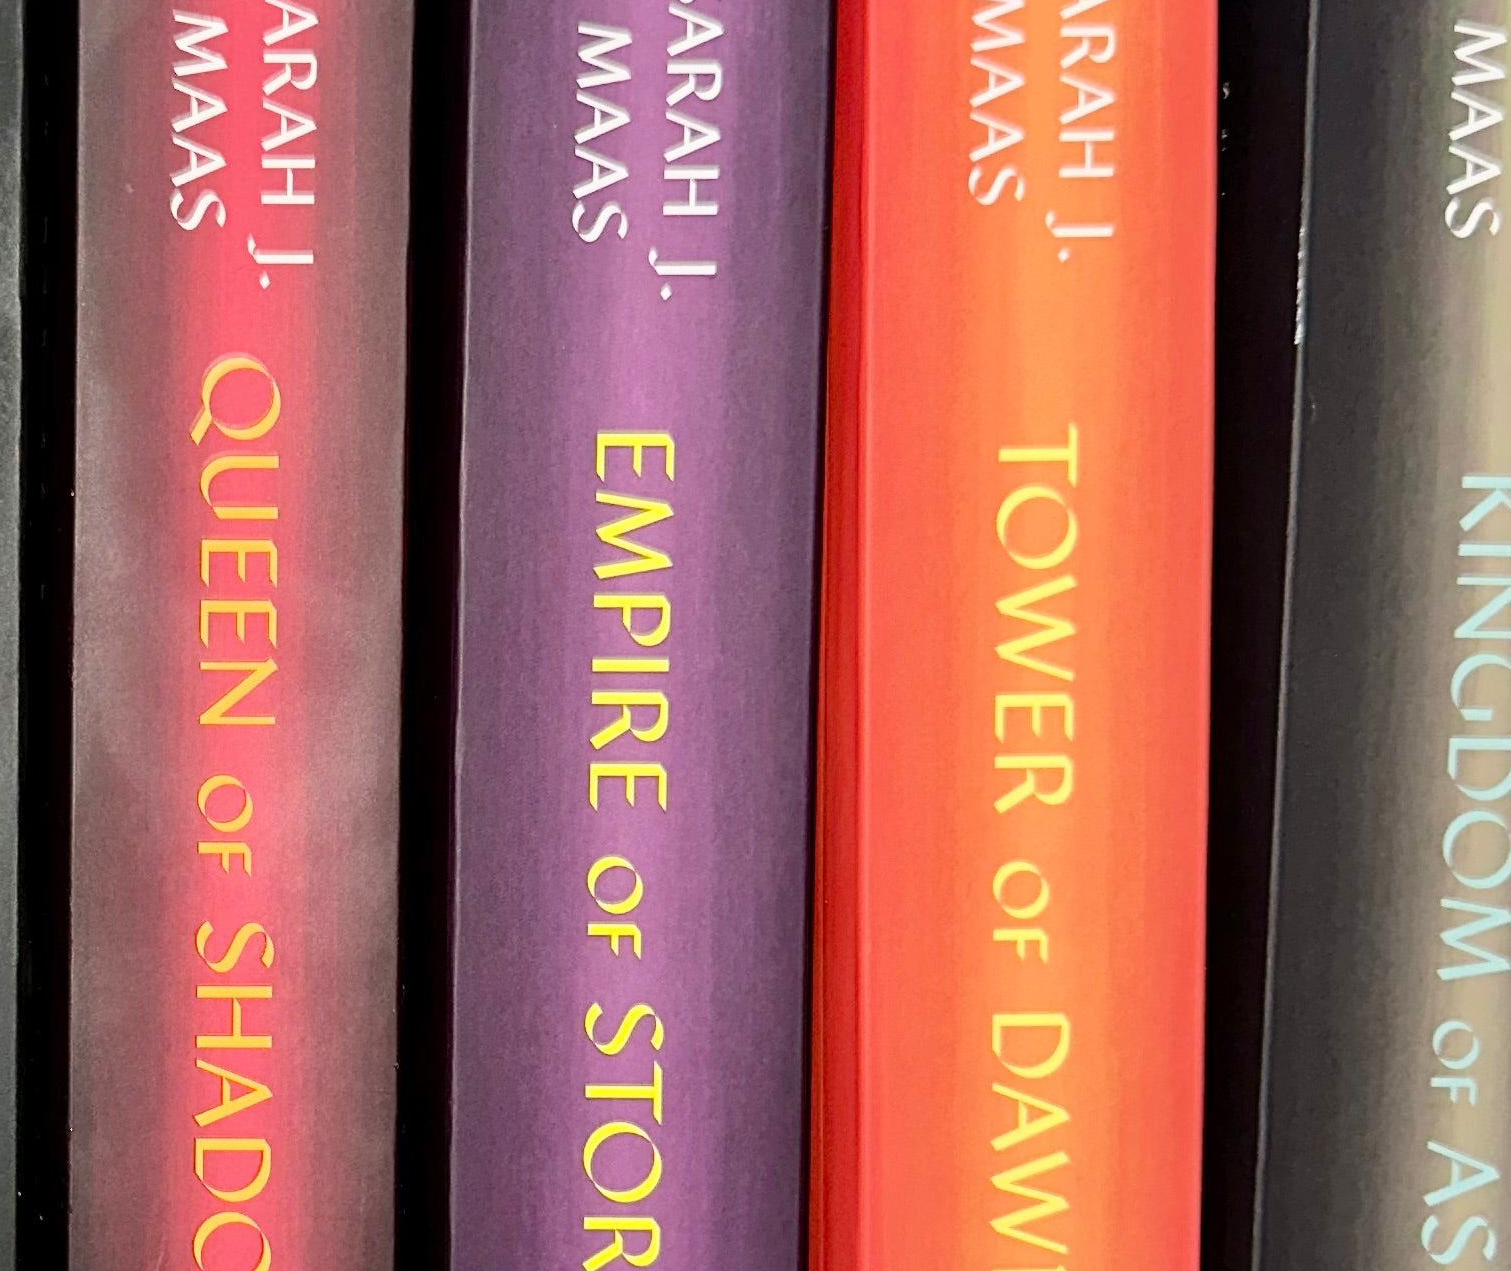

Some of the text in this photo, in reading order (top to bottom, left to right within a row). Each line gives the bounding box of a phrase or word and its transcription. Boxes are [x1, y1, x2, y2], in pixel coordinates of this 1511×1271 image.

[171, 9, 228, 232] MAAS
[571, 20, 632, 243] MAAS
[1445, 20, 1507, 239] MAAS
[247, 233, 314, 290] J.
[647, 246, 718, 301] J.
[1045, 210, 1115, 263] J.
[189, 352, 282, 726] QUEEN
[588, 429, 675, 812] EMPIRE
[993, 422, 1079, 815] TOWER
[1437, 474, 1511, 981] KINGDOM
[197, 774, 253, 877] OF
[586, 854, 644, 962] OF
[991, 860, 1050, 964] OF
[1430, 1020, 1480, 1107] OF
